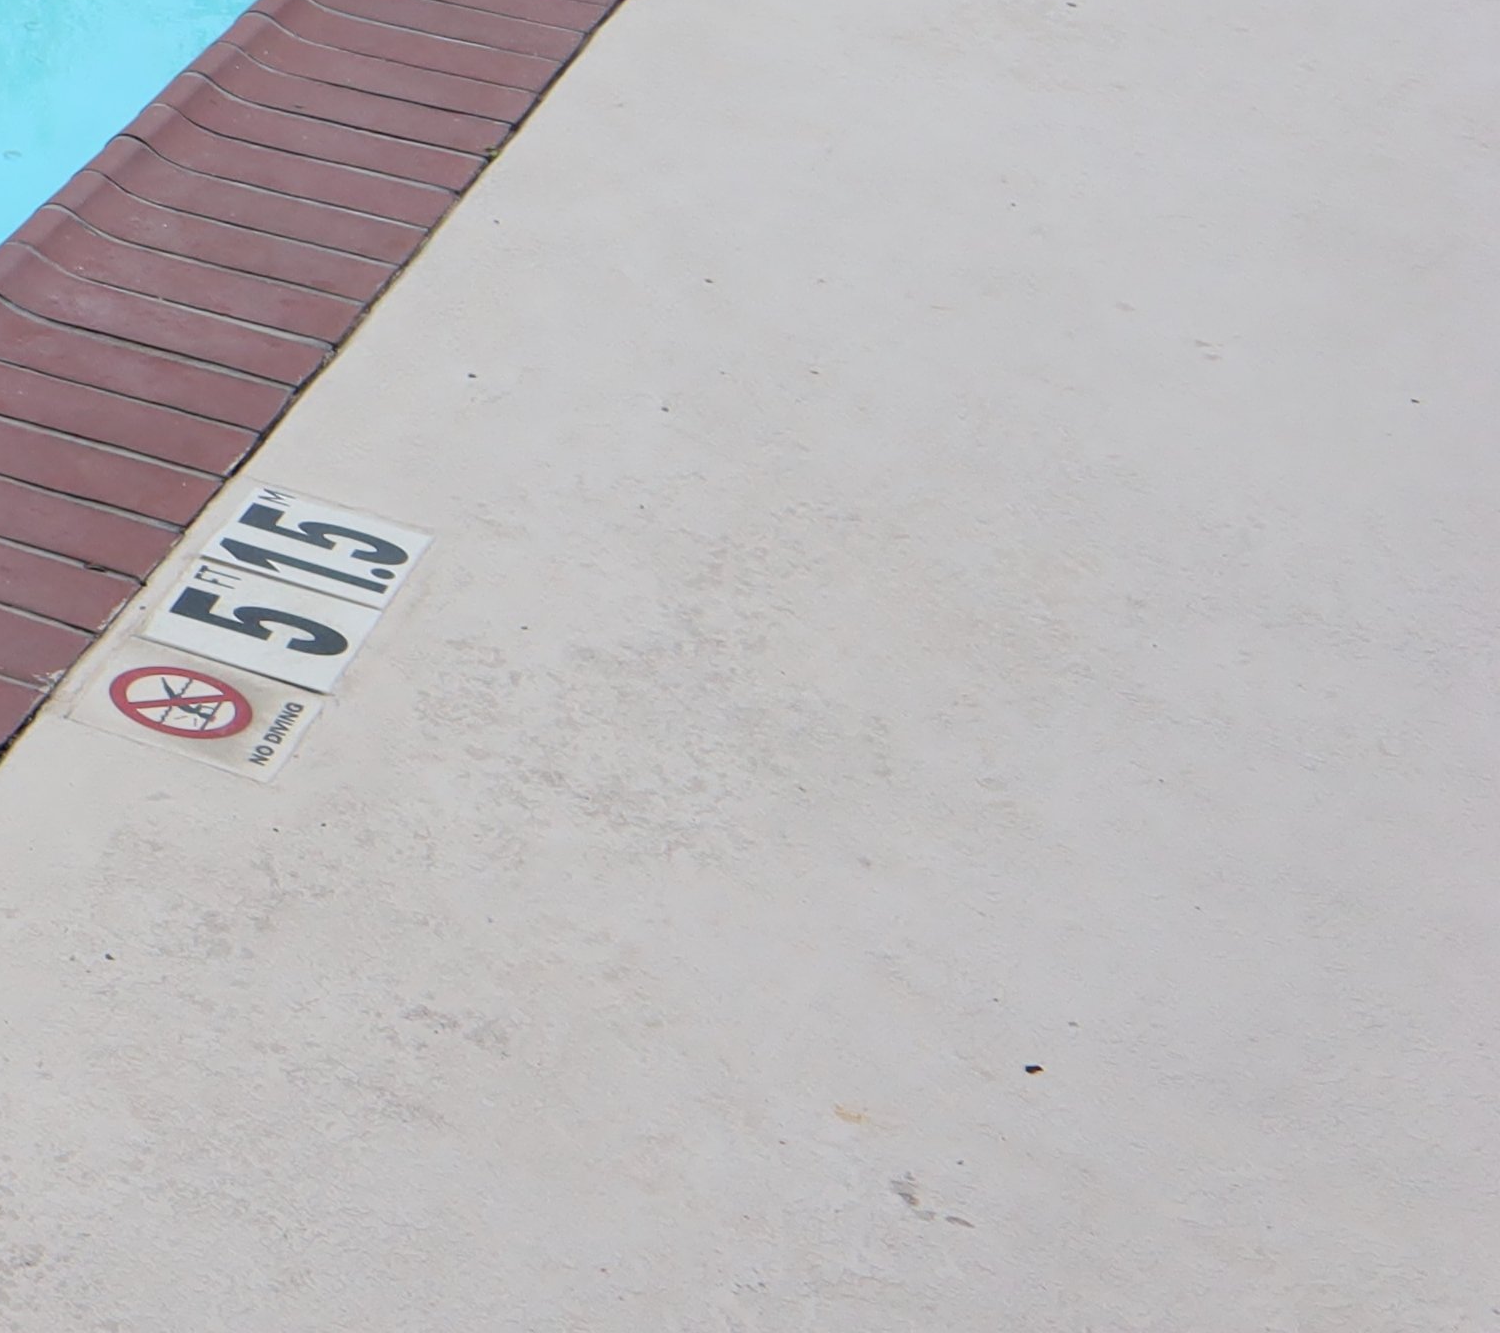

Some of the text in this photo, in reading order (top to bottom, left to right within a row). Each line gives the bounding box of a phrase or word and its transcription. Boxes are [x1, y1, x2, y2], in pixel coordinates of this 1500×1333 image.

[219, 502, 410, 595] 1.5
[169, 565, 349, 656] 5 FT
[249, 701, 305, 767] NO DIVING
